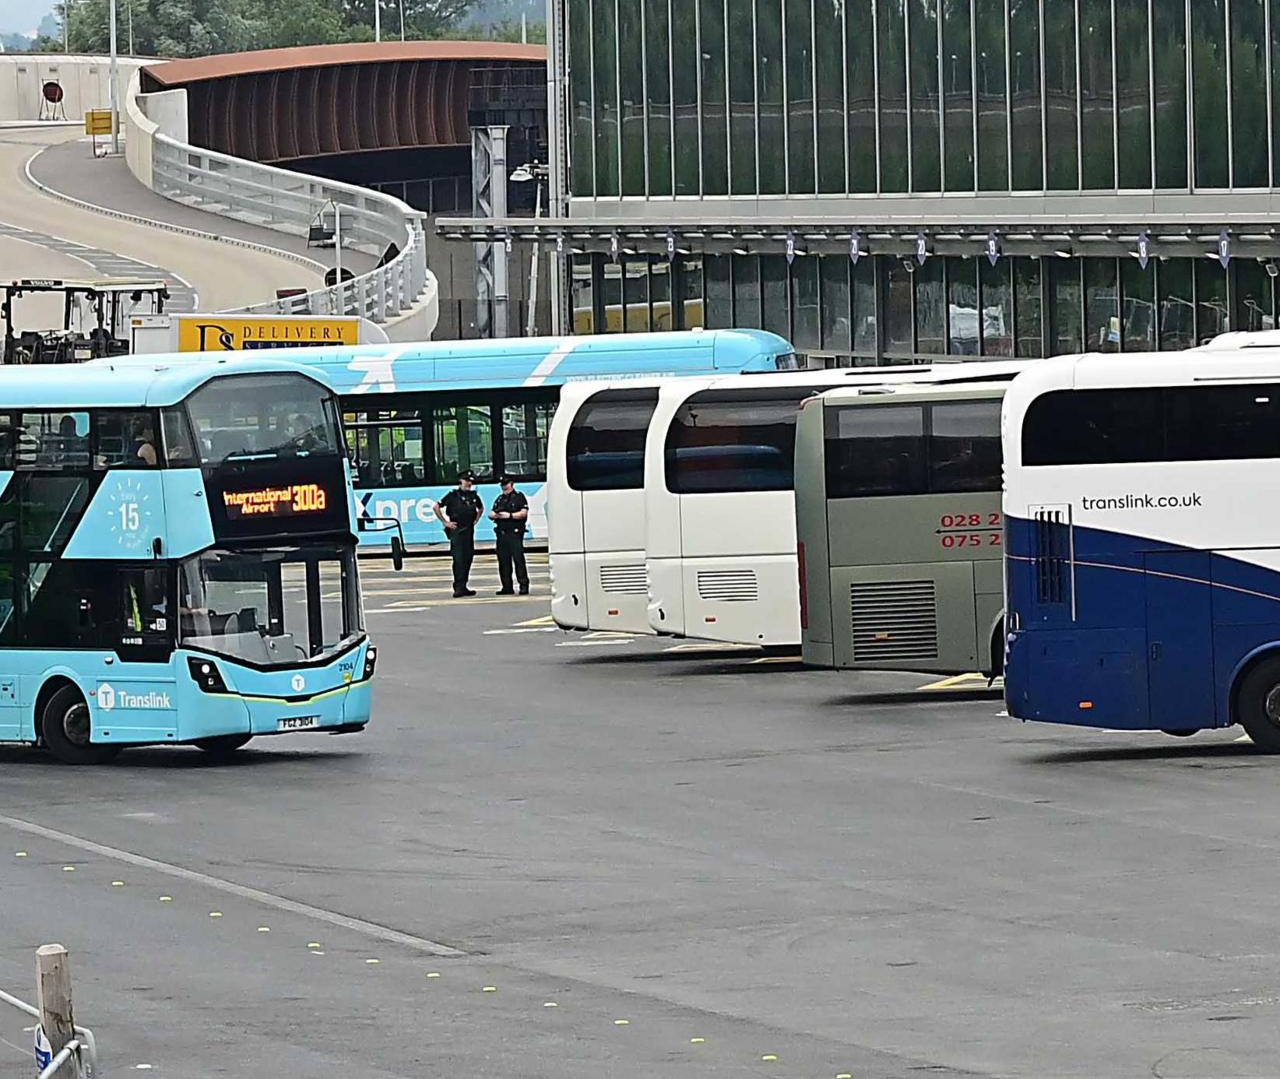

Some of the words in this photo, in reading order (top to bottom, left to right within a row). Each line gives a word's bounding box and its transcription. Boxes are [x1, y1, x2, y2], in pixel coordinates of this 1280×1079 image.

[243, 326, 343, 339] DELIVERY
[223, 486, 292, 506] International
[293, 484, 326, 512] 300a
[1082, 492, 1202, 510] translink.co.uk
[119, 503, 139, 530] 15
[241, 501, 275, 515] Airport
[941, 514, 981, 527] 028
[942, 534, 981, 548] 075
[118, 691, 171, 708] Translink
